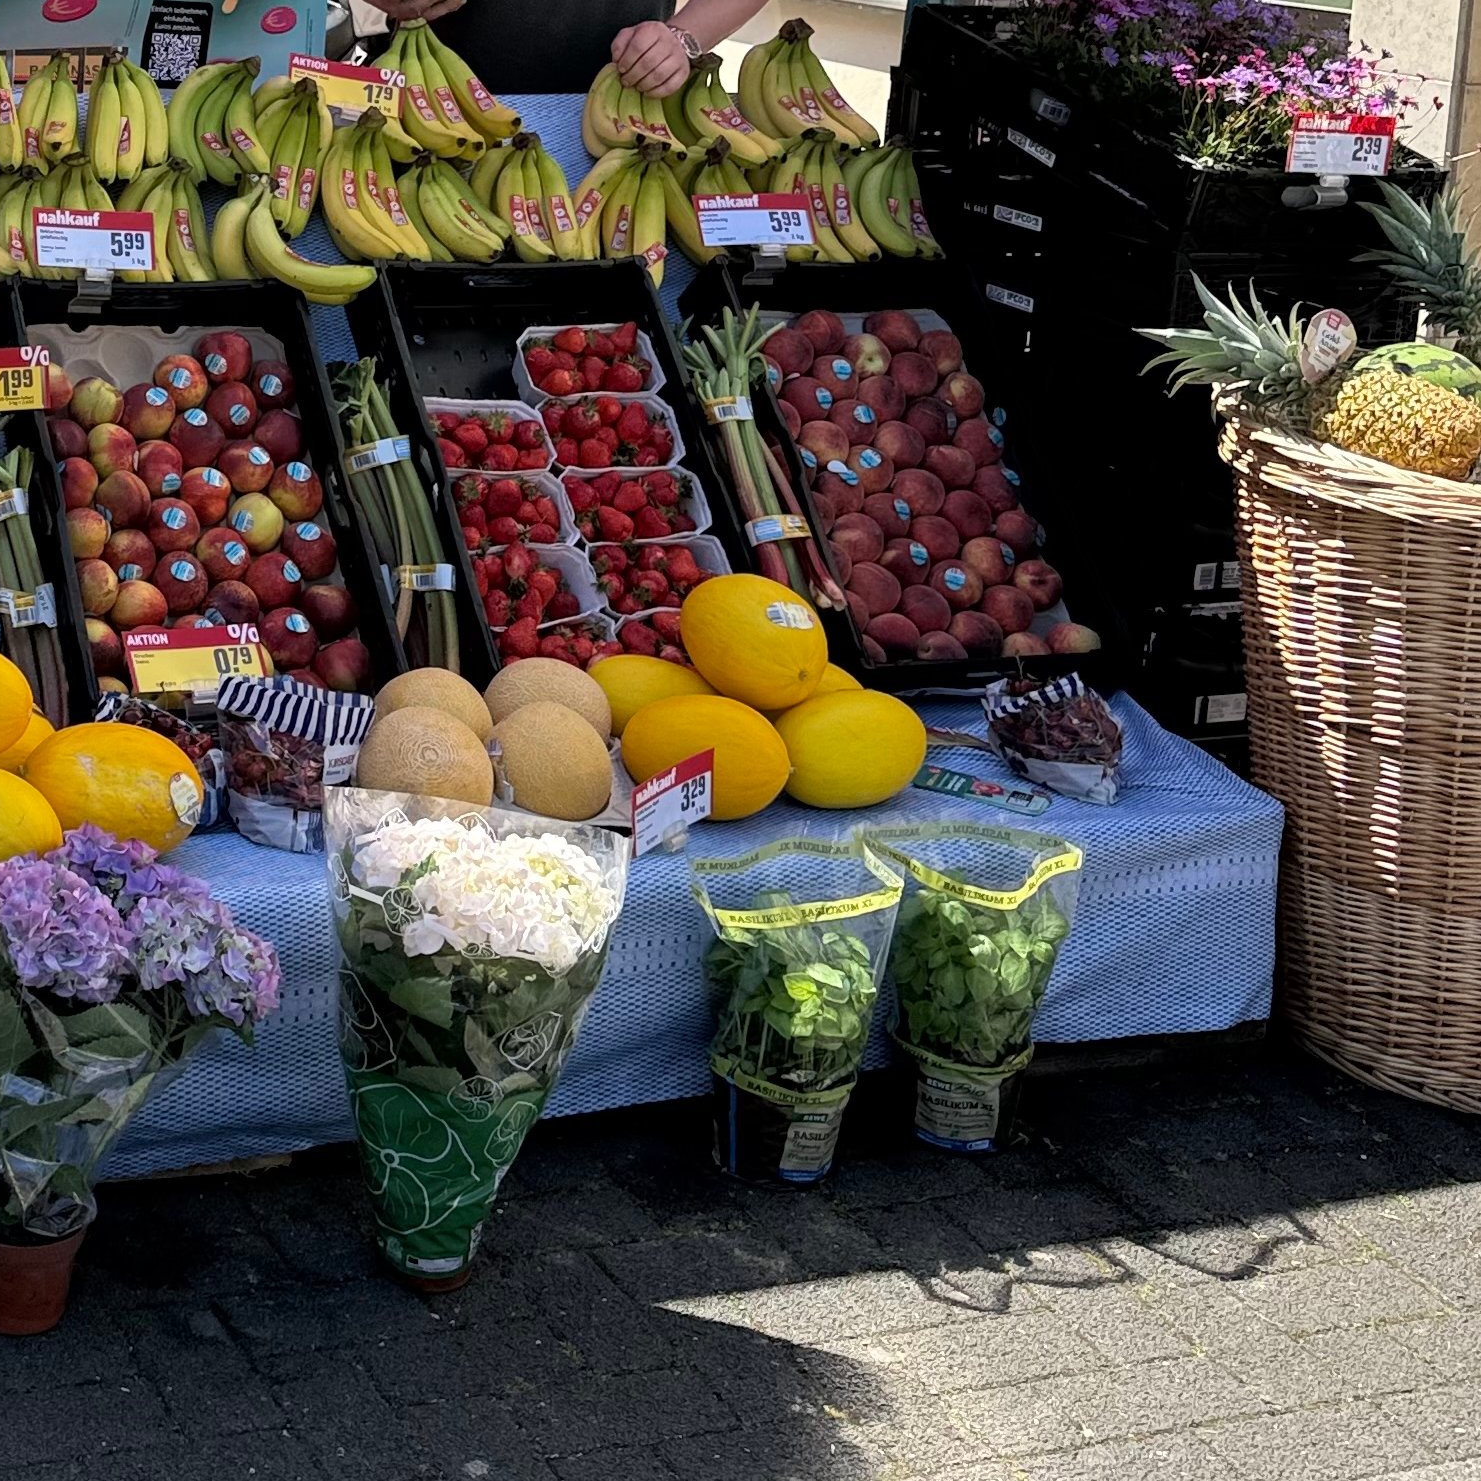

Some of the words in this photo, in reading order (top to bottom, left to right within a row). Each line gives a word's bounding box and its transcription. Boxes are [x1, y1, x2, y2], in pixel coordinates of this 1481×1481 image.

[292, 56, 329, 71] AKTION
[698, 194, 760, 210] nahkauf
[37, 209, 101, 227] nahkauf
[126, 633, 169, 646] AKTION
[635, 767, 677, 806] nahkauf
[926, 1077, 951, 1091] REWE
[920, 1092, 979, 1110] BASILIKUM
[980, 1103, 995, 1112] XL
